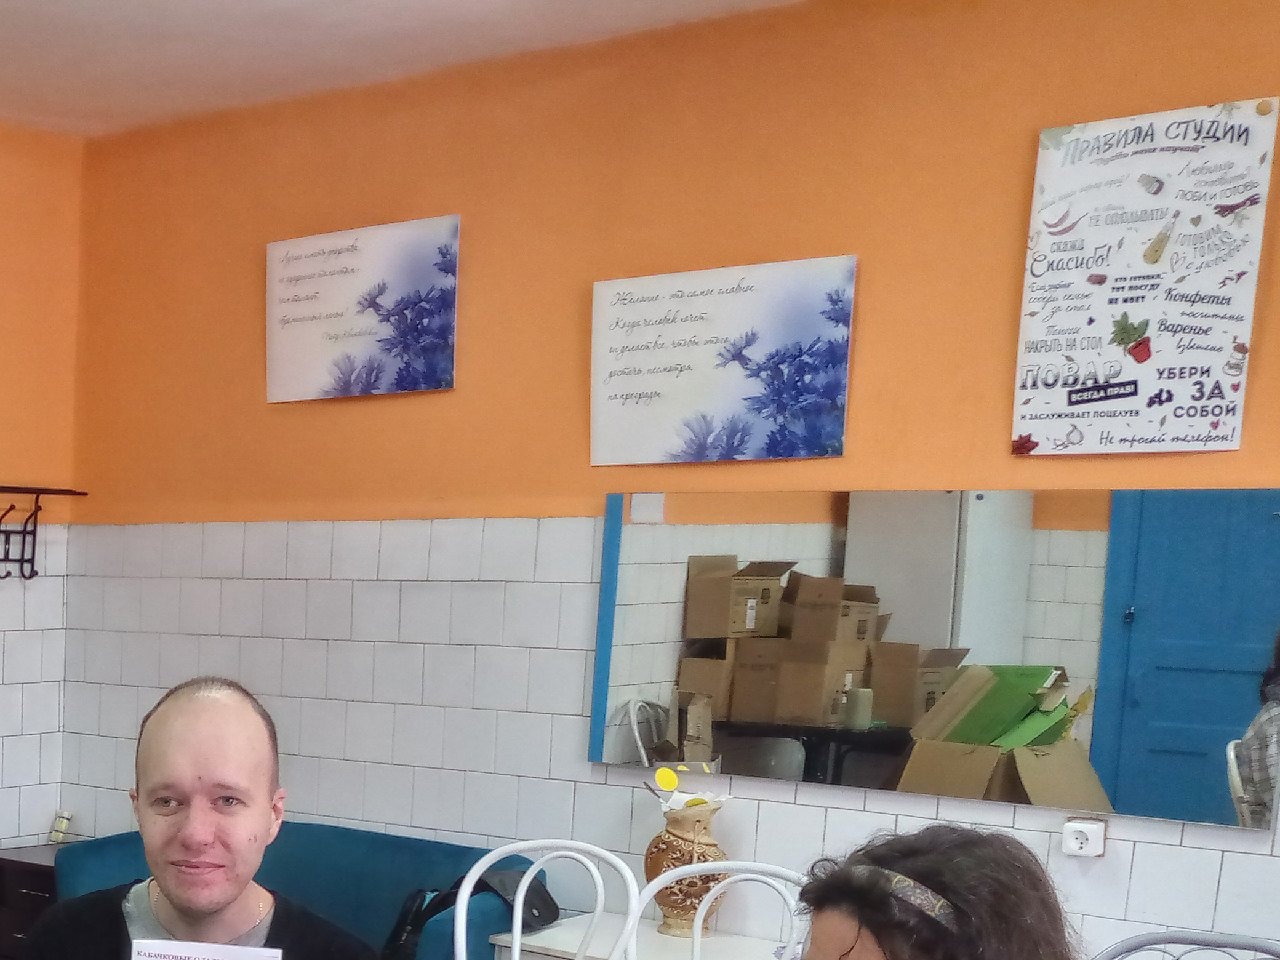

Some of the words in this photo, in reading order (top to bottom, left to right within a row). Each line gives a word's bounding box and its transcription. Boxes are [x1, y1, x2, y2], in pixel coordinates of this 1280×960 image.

[1061, 122, 1155, 167] ПРАВИЛА
[1165, 119, 1251, 146] СТУДИИ
[1030, 243, 1112, 278] Спасибо!
[1163, 286, 1233, 307] Конфеты
[1157, 318, 1213, 337] Варенье
[1019, 360, 1123, 391] ПОВАР
[1156, 366, 1211, 380] УБЕРИ
[1070, 389, 1106, 402] ВСЕГДА
[1190, 380, 1226, 401] ЗА
[1028, 411, 1091, 420] ЗАСЛУЖИВАЕТ
[1093, 409, 1140, 418] ПОЦЕЛУЕВ
[1173, 400, 1238, 418] СОБОЙ
[1099, 430, 1114, 446] Не
[1169, 426, 1237, 447] телефон!
